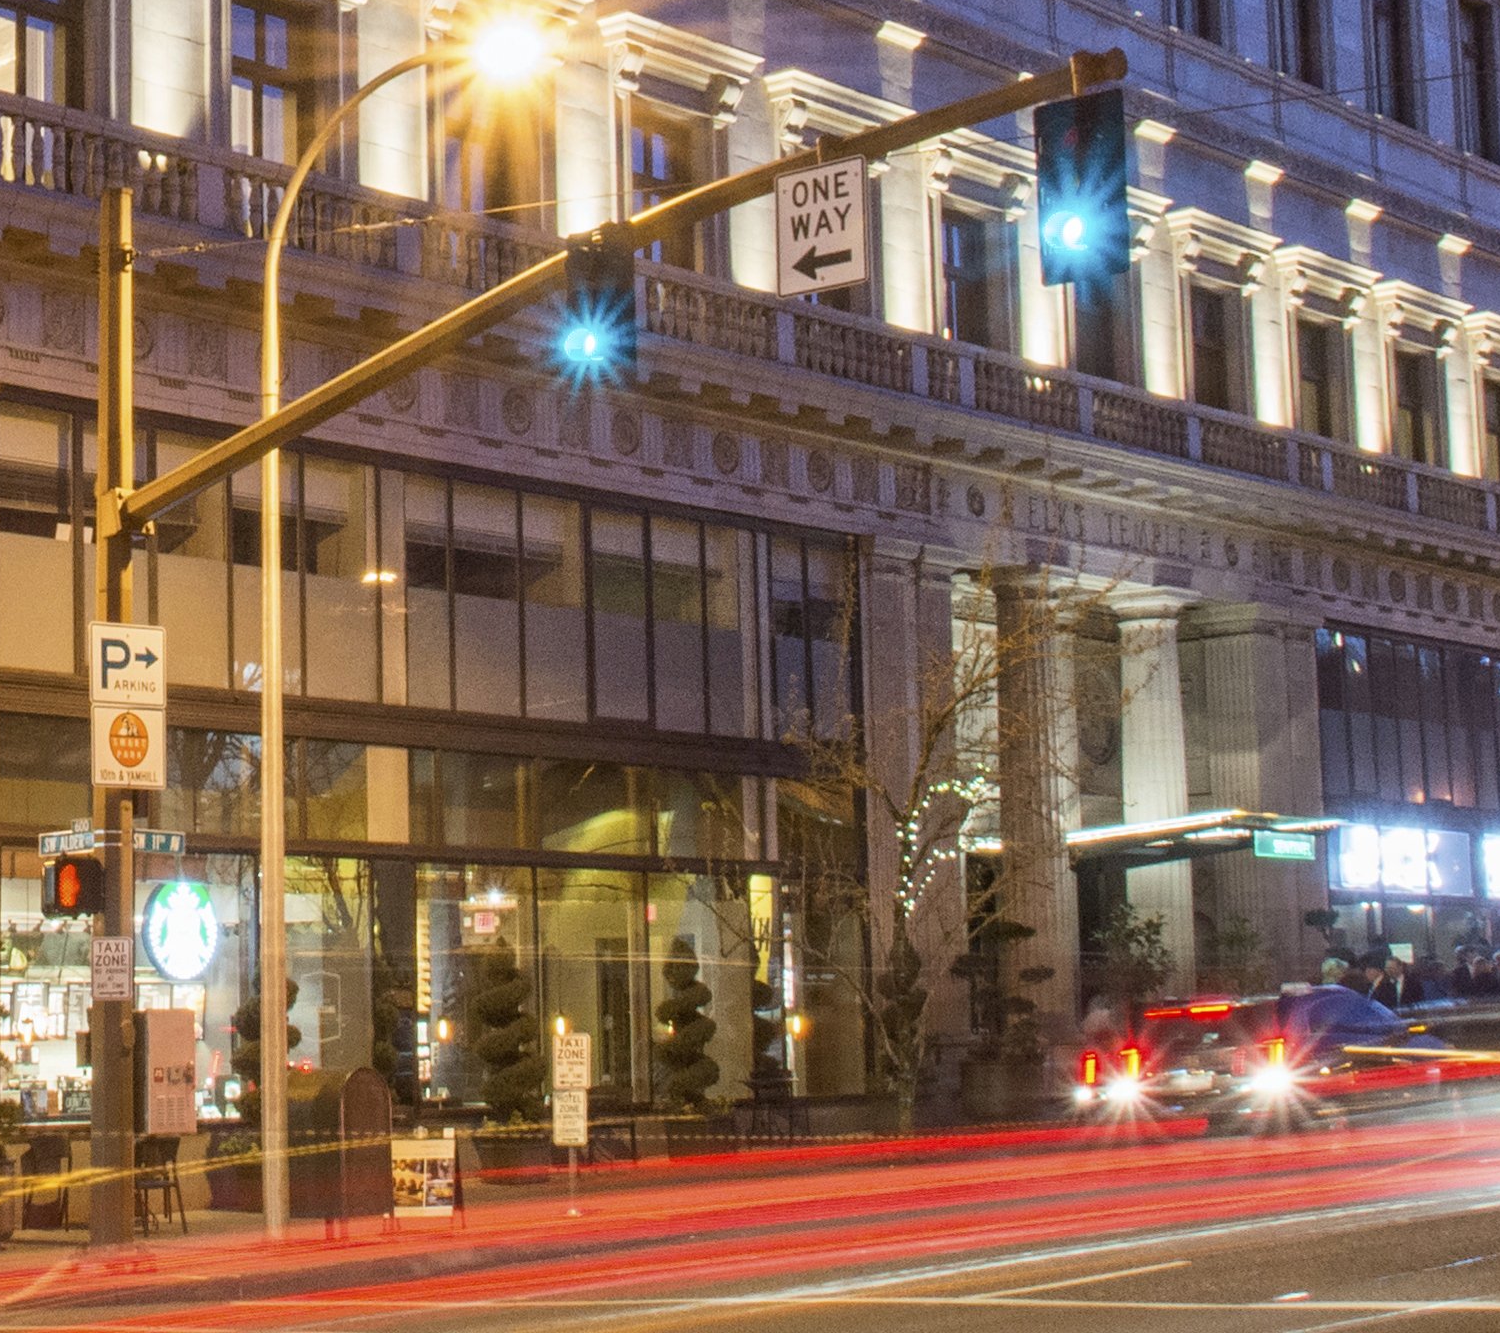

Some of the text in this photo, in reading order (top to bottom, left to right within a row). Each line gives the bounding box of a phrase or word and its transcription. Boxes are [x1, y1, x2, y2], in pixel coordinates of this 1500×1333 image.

[792, 170, 849, 207] ONE
[790, 203, 852, 242] WAY
[127, 771, 158, 783] YAMHILL
[97, 942, 125, 953] TAXI
[95, 954, 127, 967] ZONE
[560, 1037, 585, 1048] TAXI
[557, 1049, 585, 1060] ZONE
